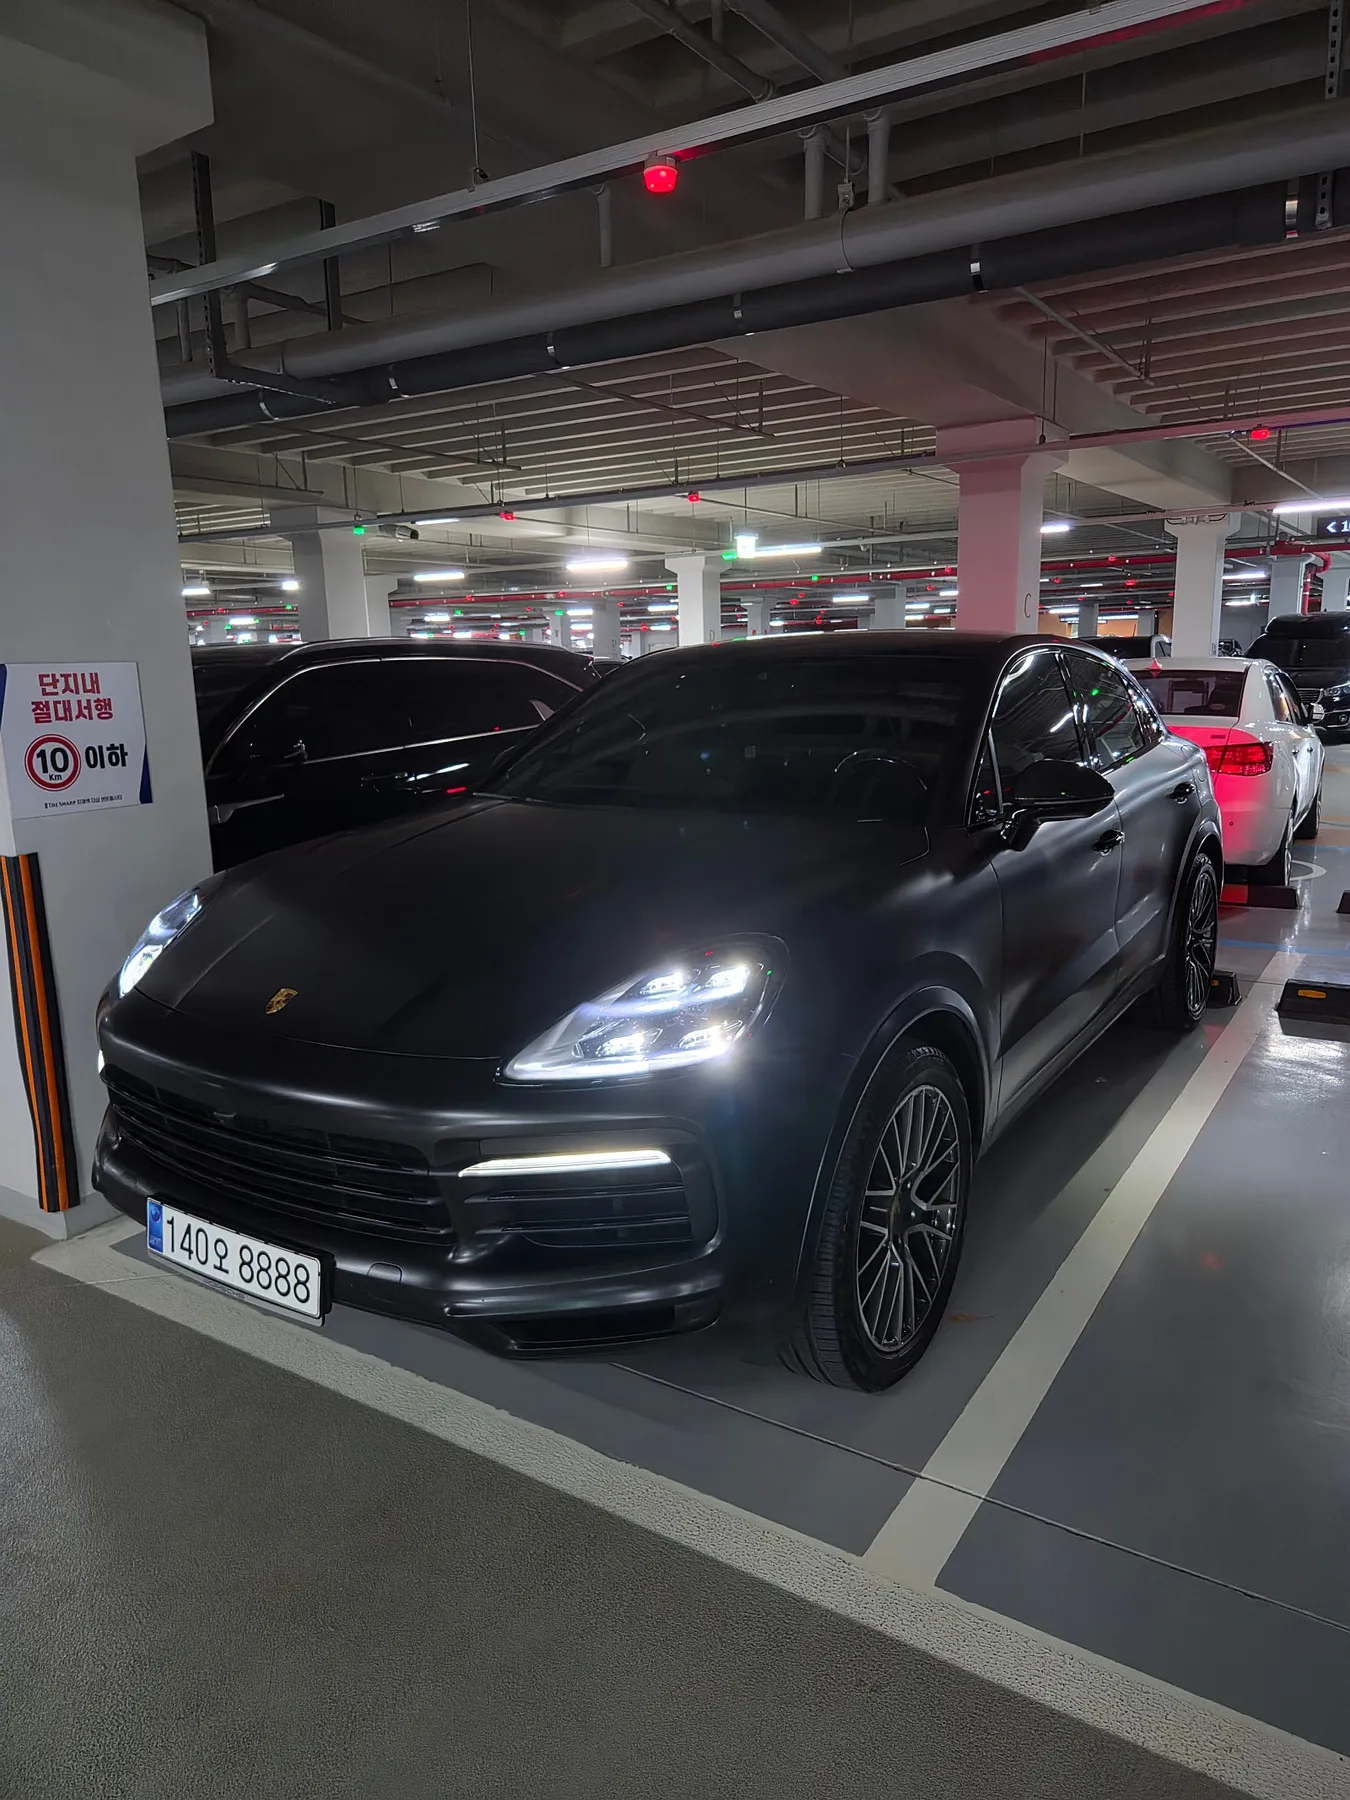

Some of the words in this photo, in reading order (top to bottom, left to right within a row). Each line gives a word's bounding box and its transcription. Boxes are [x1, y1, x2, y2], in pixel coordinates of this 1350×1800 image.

[38, 672, 101, 697] 단지내
[31, 697, 114, 724] 절대서행
[36, 747, 70, 774] 10
[84, 743, 129, 769] 이하
[166, 1215, 230, 1275] 140오
[238, 1244, 311, 1304] 8888
